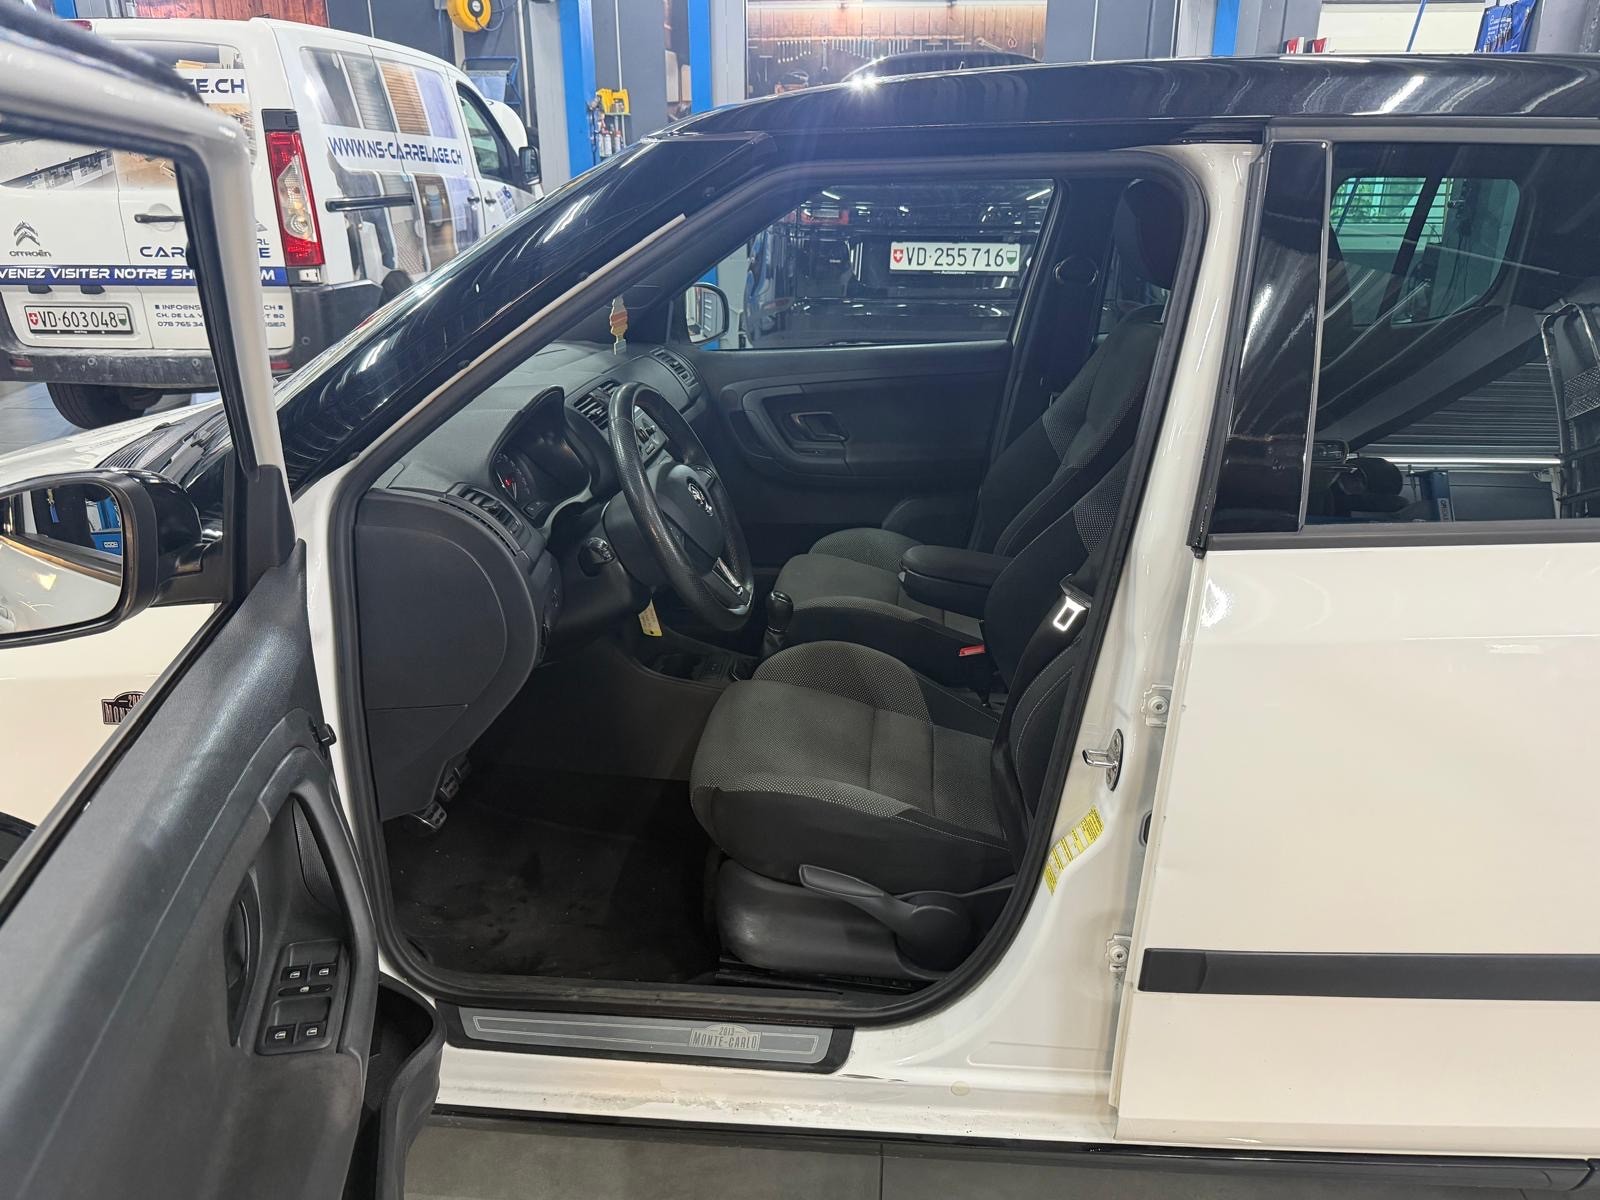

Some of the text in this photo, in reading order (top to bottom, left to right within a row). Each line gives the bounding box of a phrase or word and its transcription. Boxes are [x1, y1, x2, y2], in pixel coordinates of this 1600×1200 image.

[328, 136, 463, 165] WWW.NS-CARRELAGE.CH
[0, 268, 46, 279] VENEZ
[49, 268, 110, 279] VISITER
[114, 268, 167, 279] NOTRE
[693, 1031, 757, 1049] MONTE-CARLO
